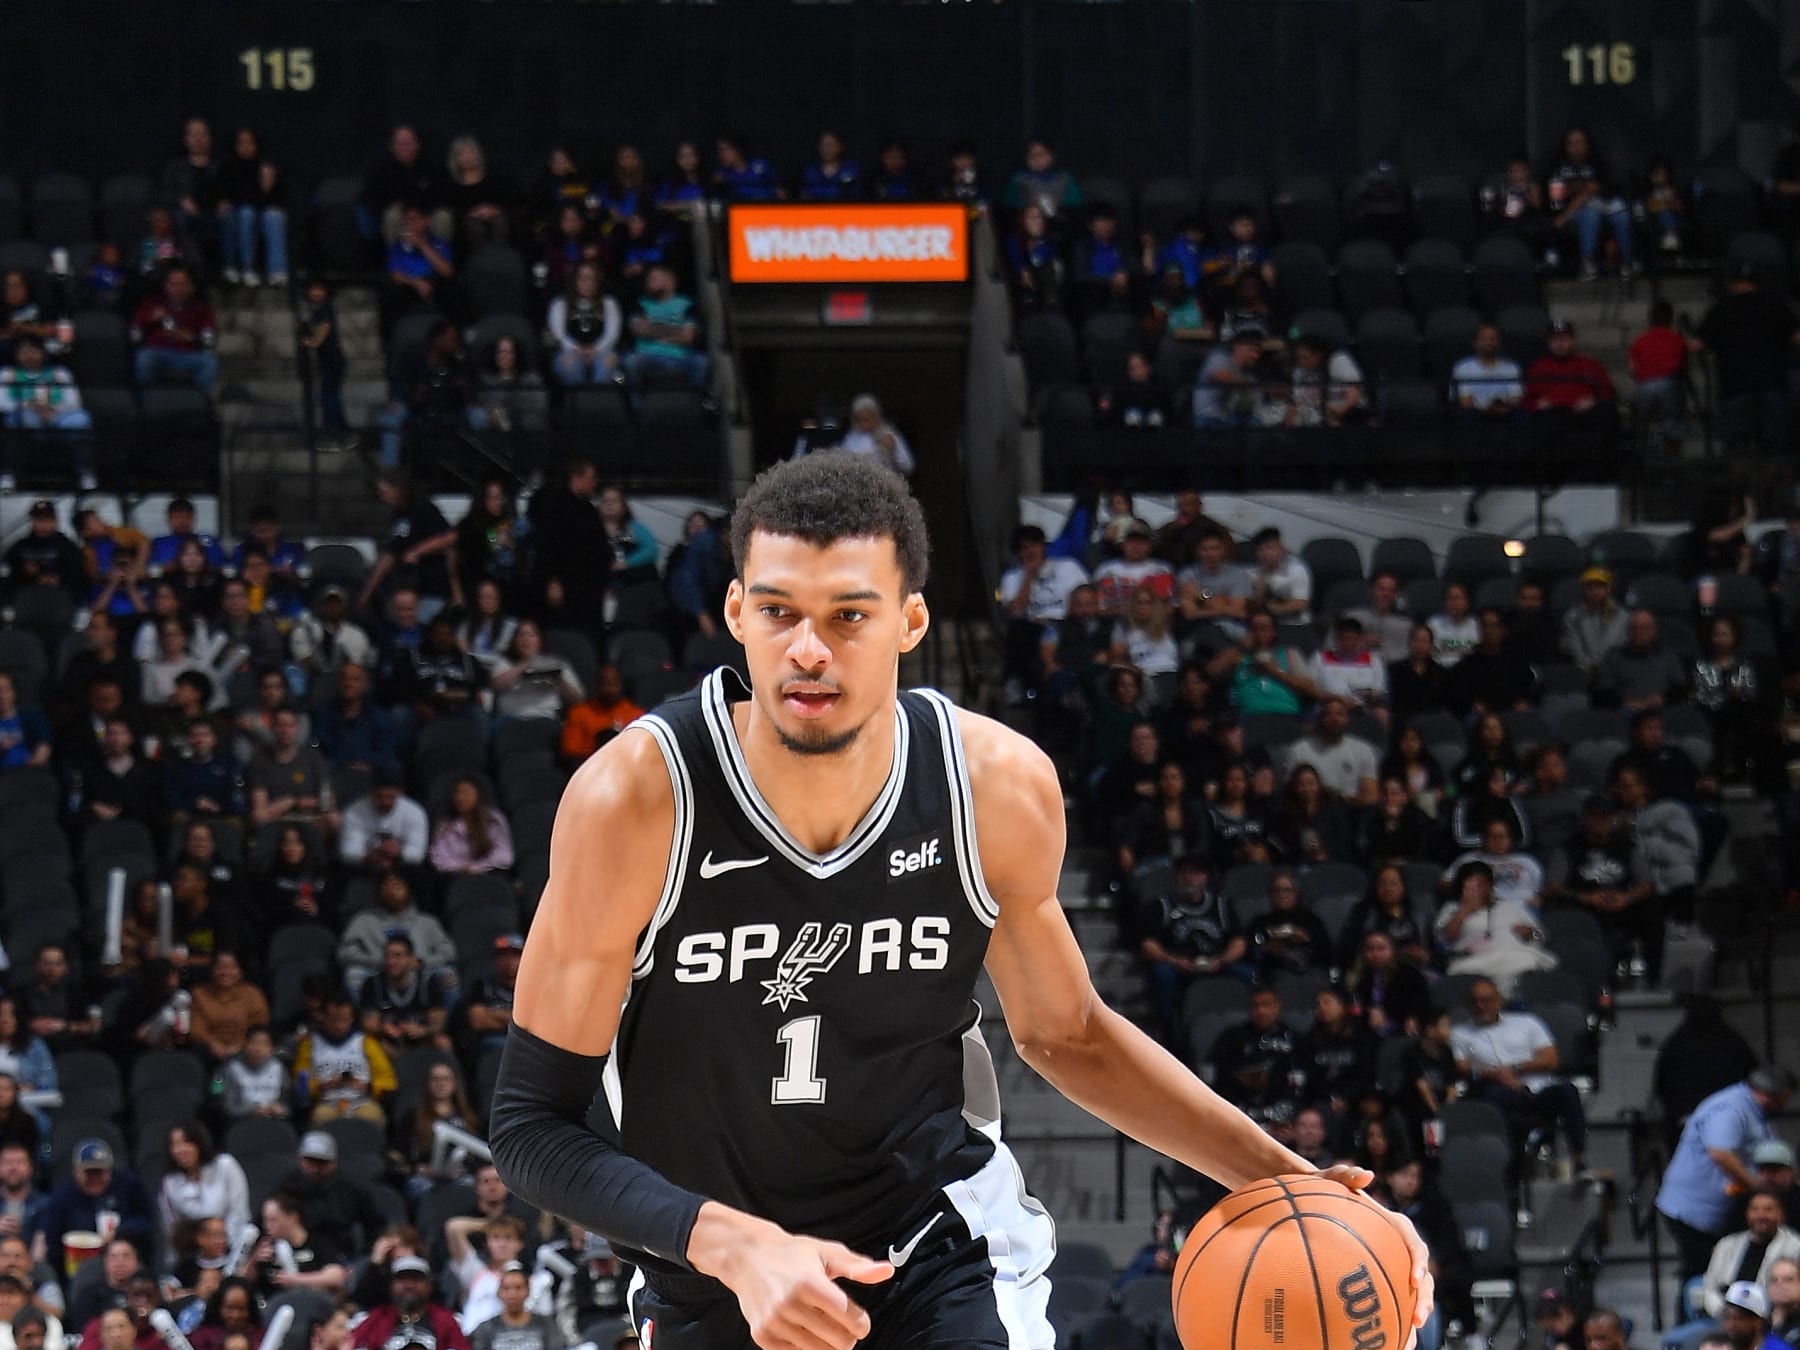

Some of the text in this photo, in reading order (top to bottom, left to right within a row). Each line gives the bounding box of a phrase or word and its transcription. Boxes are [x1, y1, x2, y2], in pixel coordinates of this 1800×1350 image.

[240, 47, 316, 92] 115
[1563, 42, 1636, 86] 116
[743, 225, 953, 263] WHATABURGER
[674, 916, 950, 1012] SPURS
[771, 1015, 827, 1105] 1
